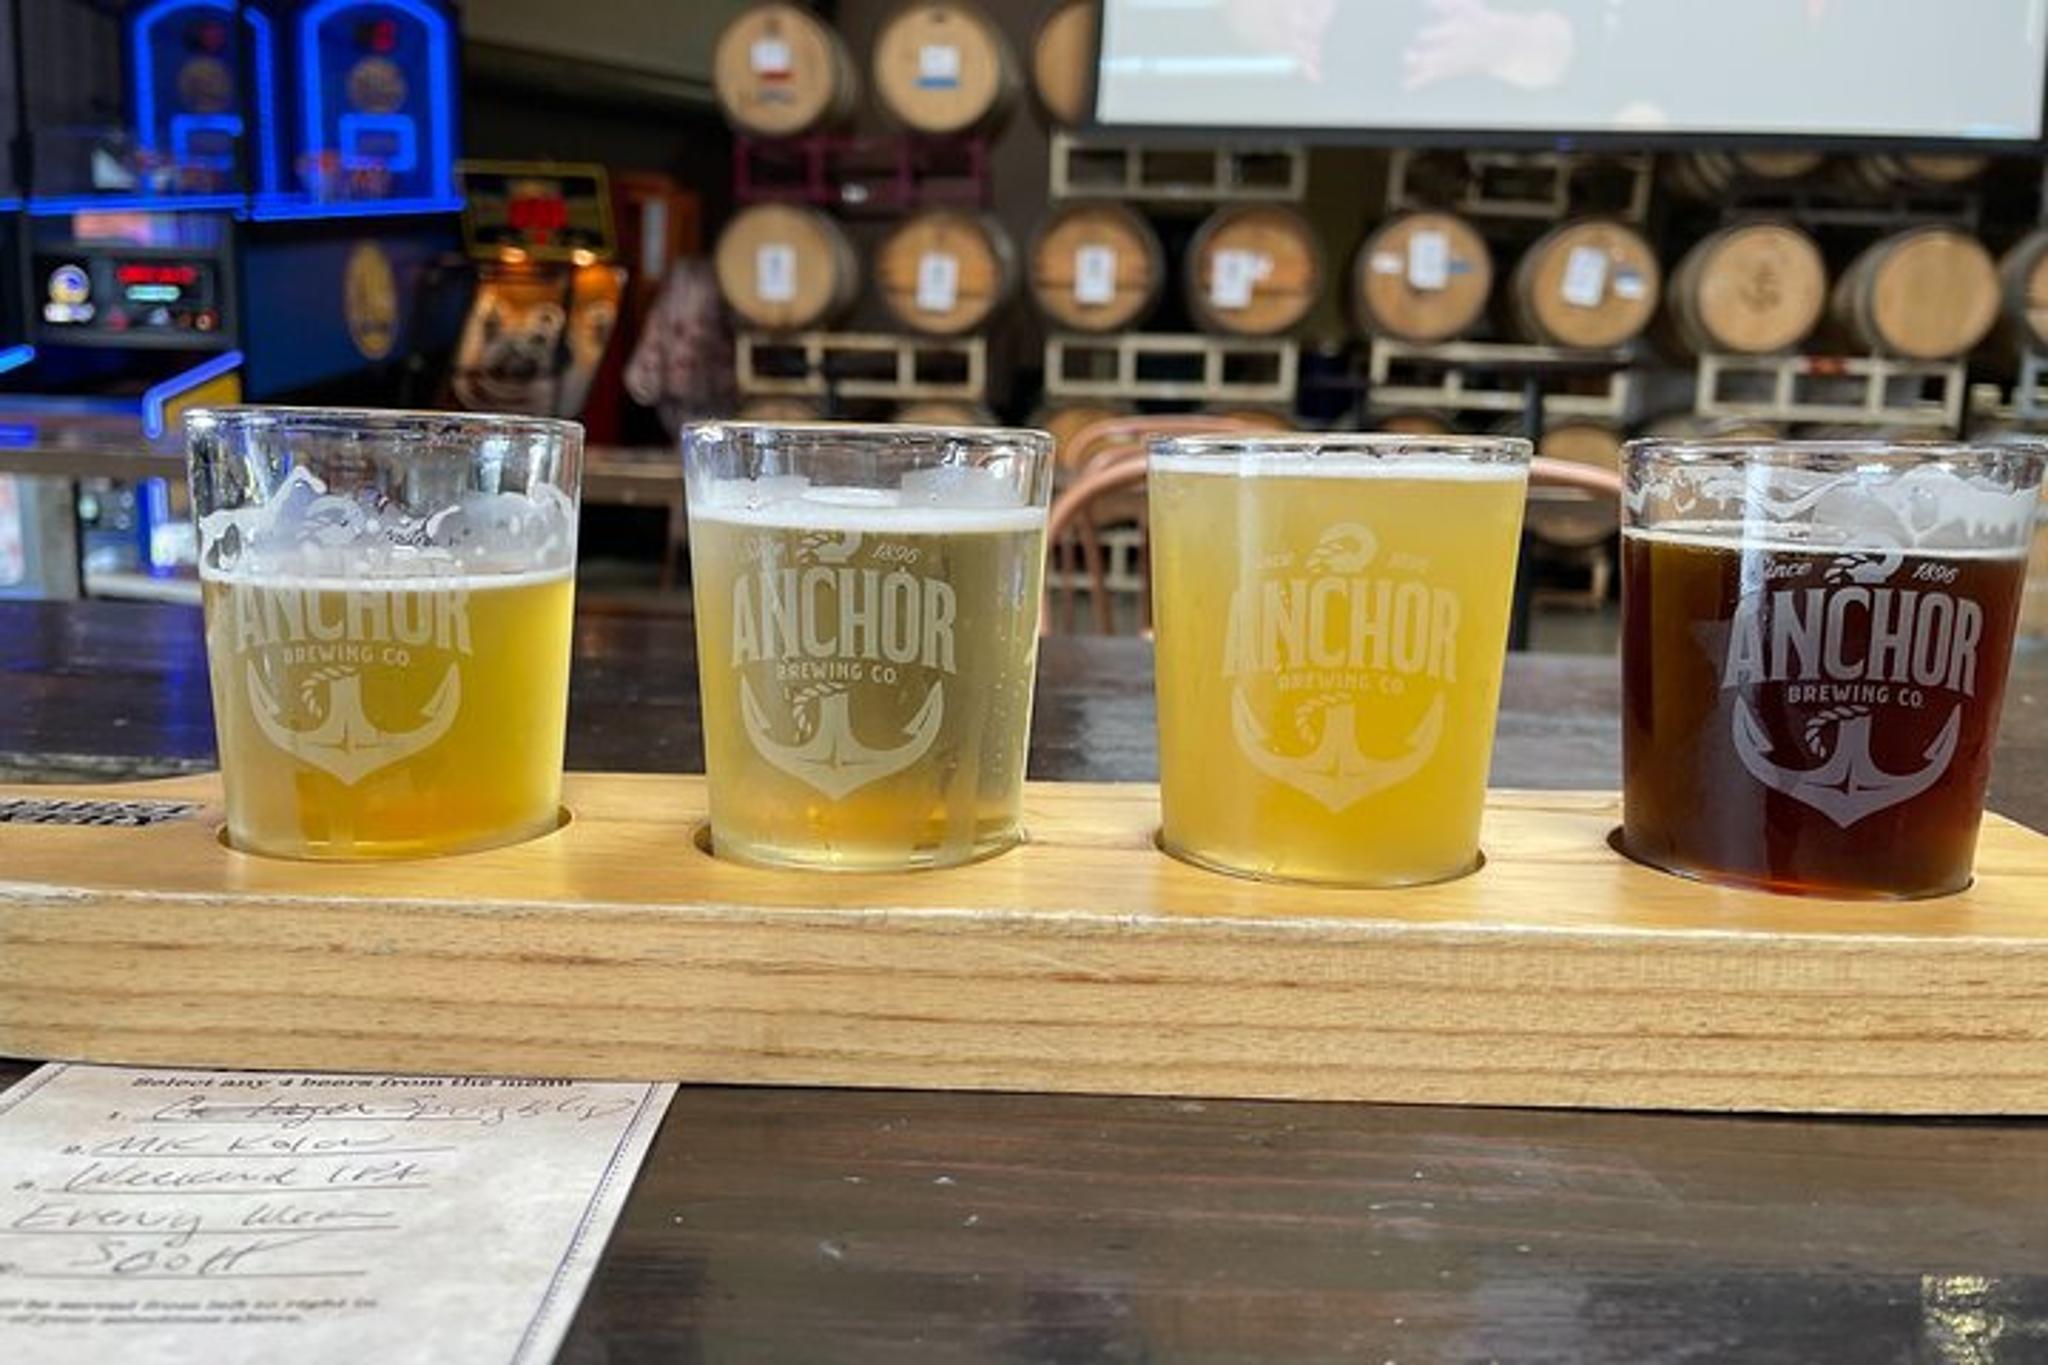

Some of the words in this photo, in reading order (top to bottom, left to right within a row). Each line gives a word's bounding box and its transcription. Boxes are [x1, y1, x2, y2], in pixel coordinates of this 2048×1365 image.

[1911, 563, 1960, 583] 1896
[731, 566, 957, 674] ANCHOR
[1221, 577, 1461, 683] ANCHOR
[1723, 586, 1983, 697] ANCHOR
[283, 645, 374, 664] BREWING
[383, 648, 411, 668] CO
[776, 661, 863, 682] BREWING
[870, 666, 897, 685] CO
[1277, 671, 1370, 691] BREWING
[1787, 685, 1889, 704] BREWING
[132, 1077, 213, 1087] Select
[219, 1078, 270, 1090] any
[300, 1077, 374, 1087] beers
[379, 1077, 443, 1087] from
[450, 1076, 493, 1087] the
[499, 1077, 573, 1087] menu
